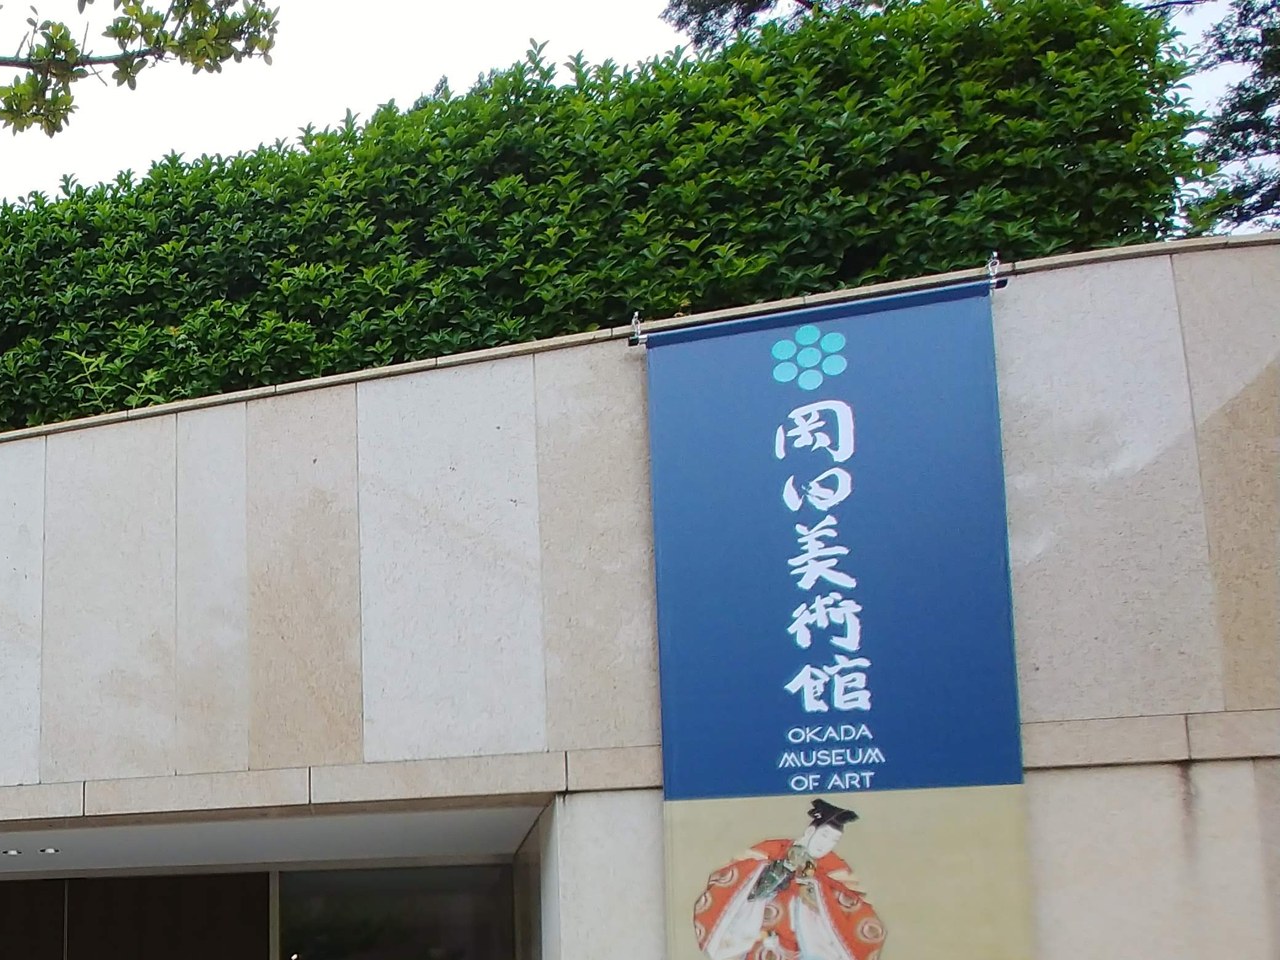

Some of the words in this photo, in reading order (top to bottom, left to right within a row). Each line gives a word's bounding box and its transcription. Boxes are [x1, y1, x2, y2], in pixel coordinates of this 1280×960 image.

[775, 400, 873, 713] 岡田美術館
[787, 723, 874, 743] OKADA
[778, 747, 886, 768] MUSEUM
[790, 774, 821, 791] OF
[827, 771, 875, 790] ART
